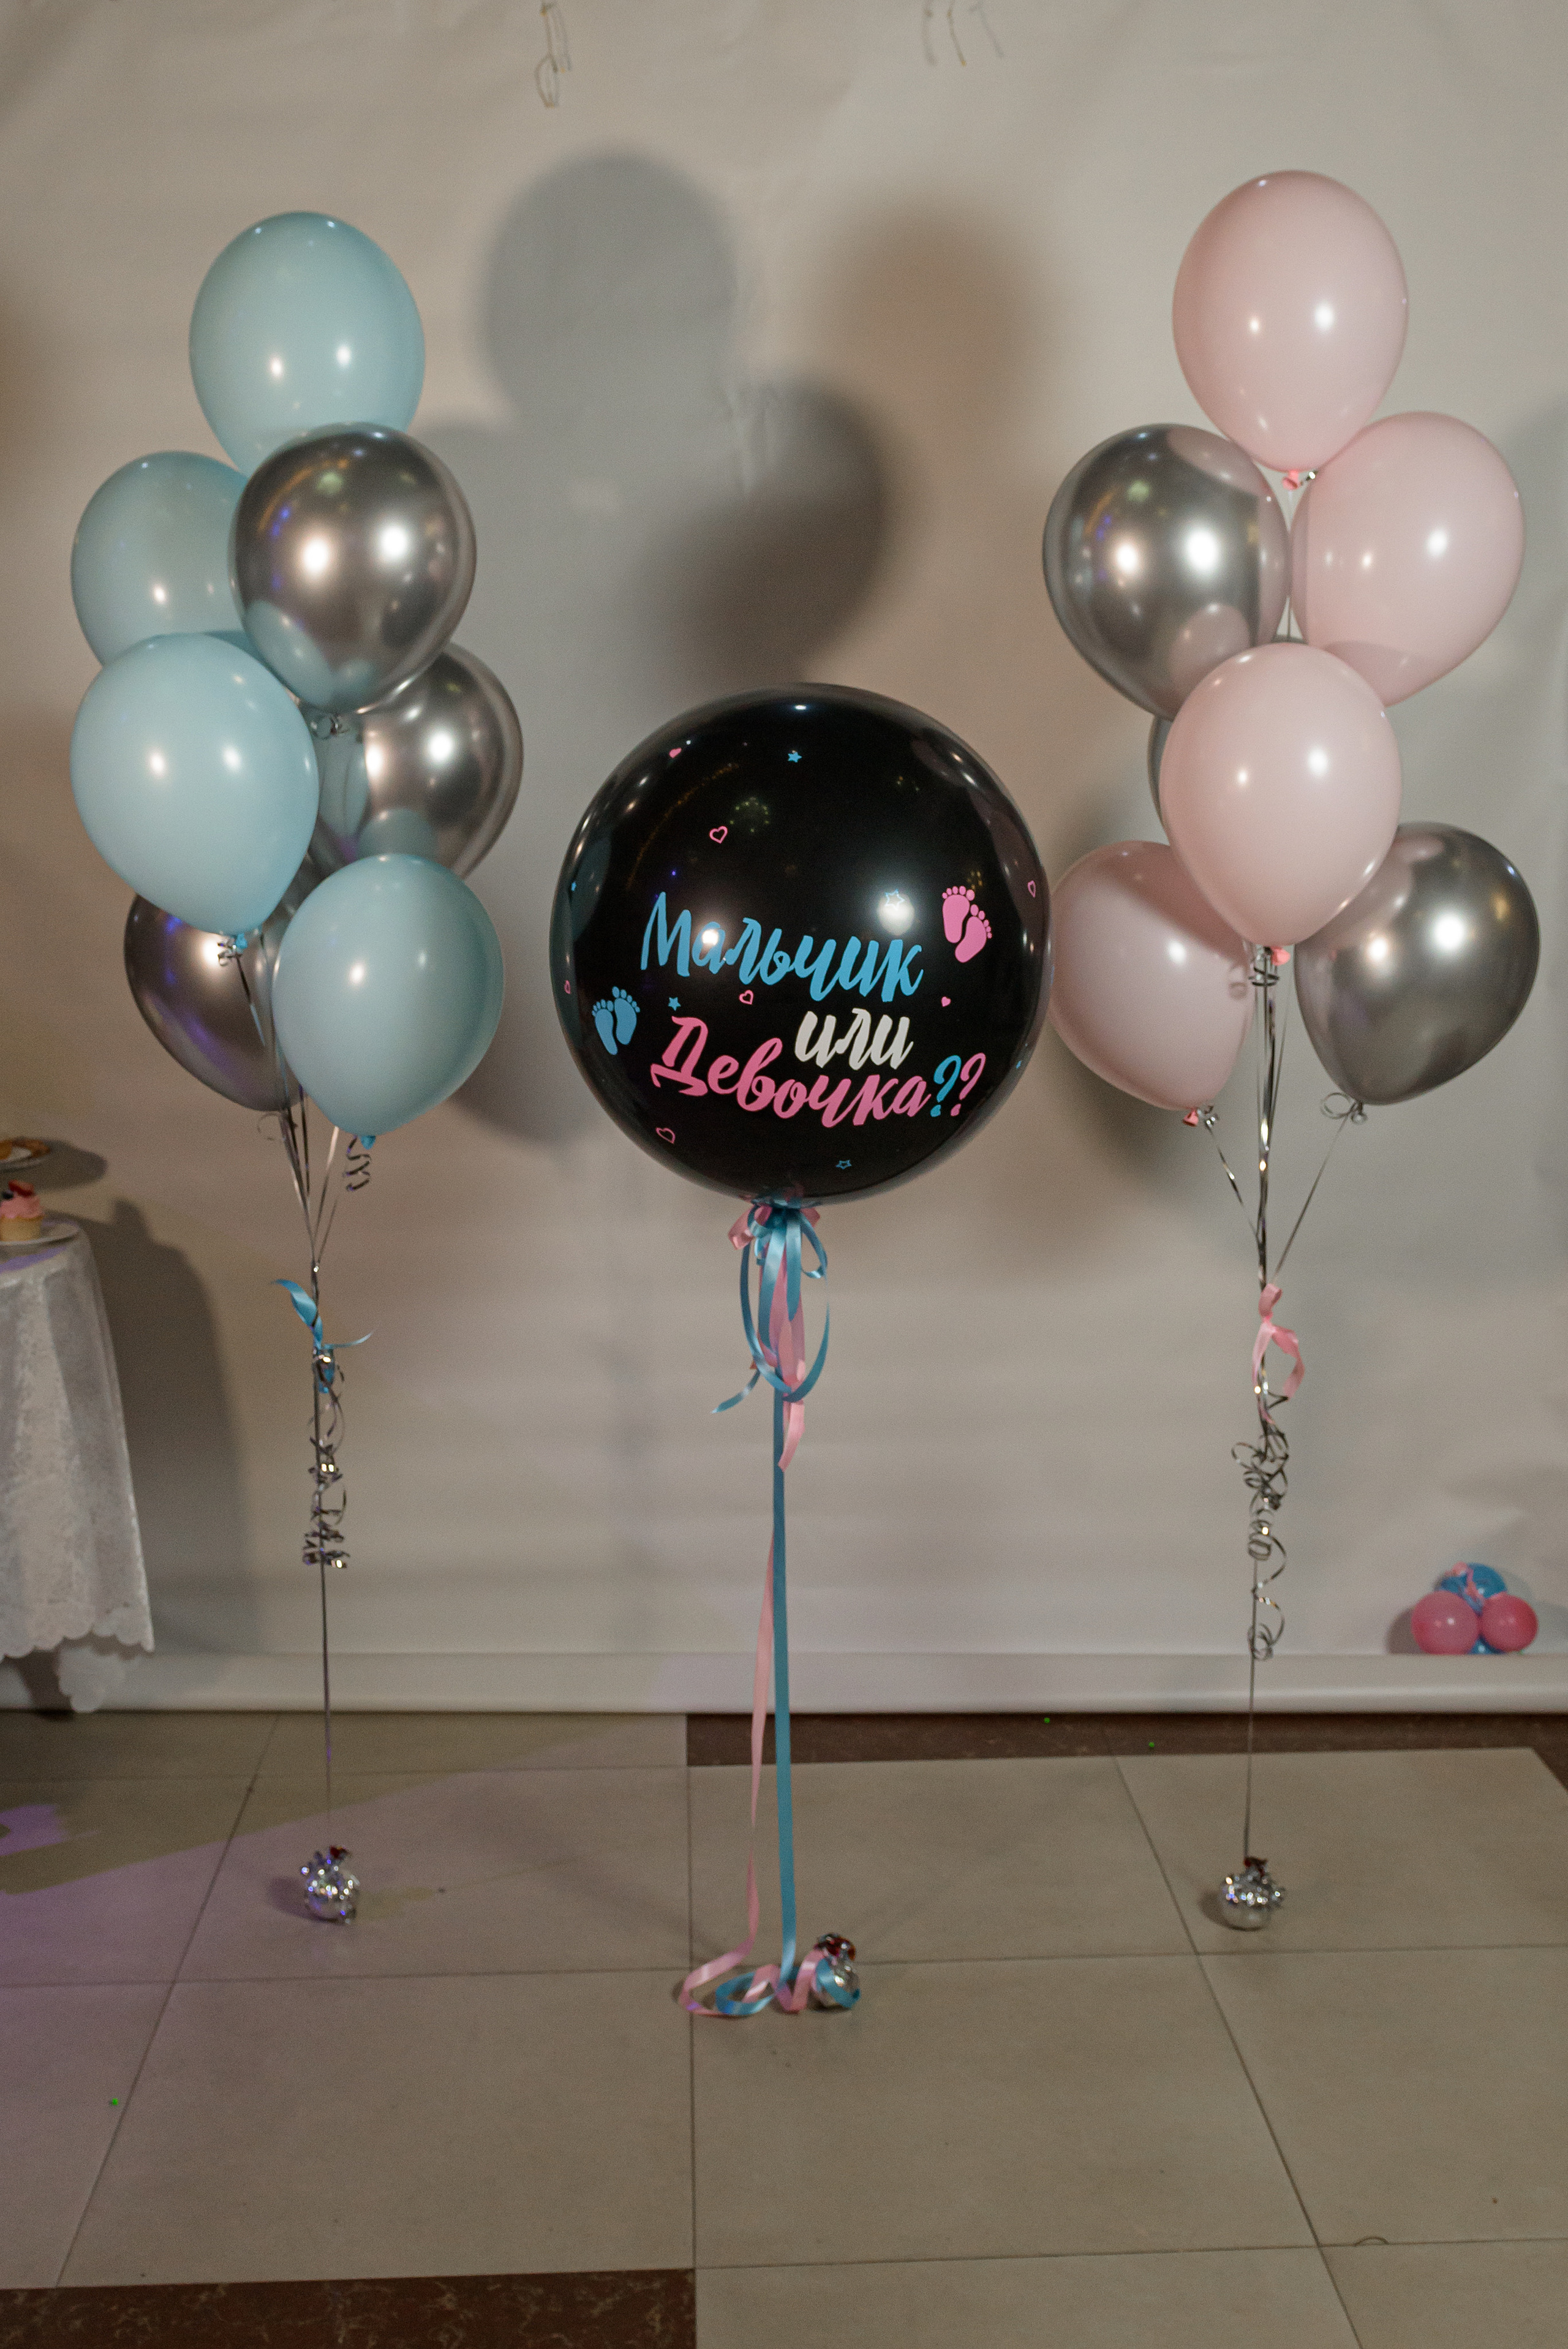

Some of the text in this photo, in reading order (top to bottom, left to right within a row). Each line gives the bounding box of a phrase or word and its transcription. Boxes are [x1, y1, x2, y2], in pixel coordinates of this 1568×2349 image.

[641, 891, 924, 1002] Мальчик
[651, 1016, 986, 1128] Девочка??
[794, 1008, 913, 1070] или
